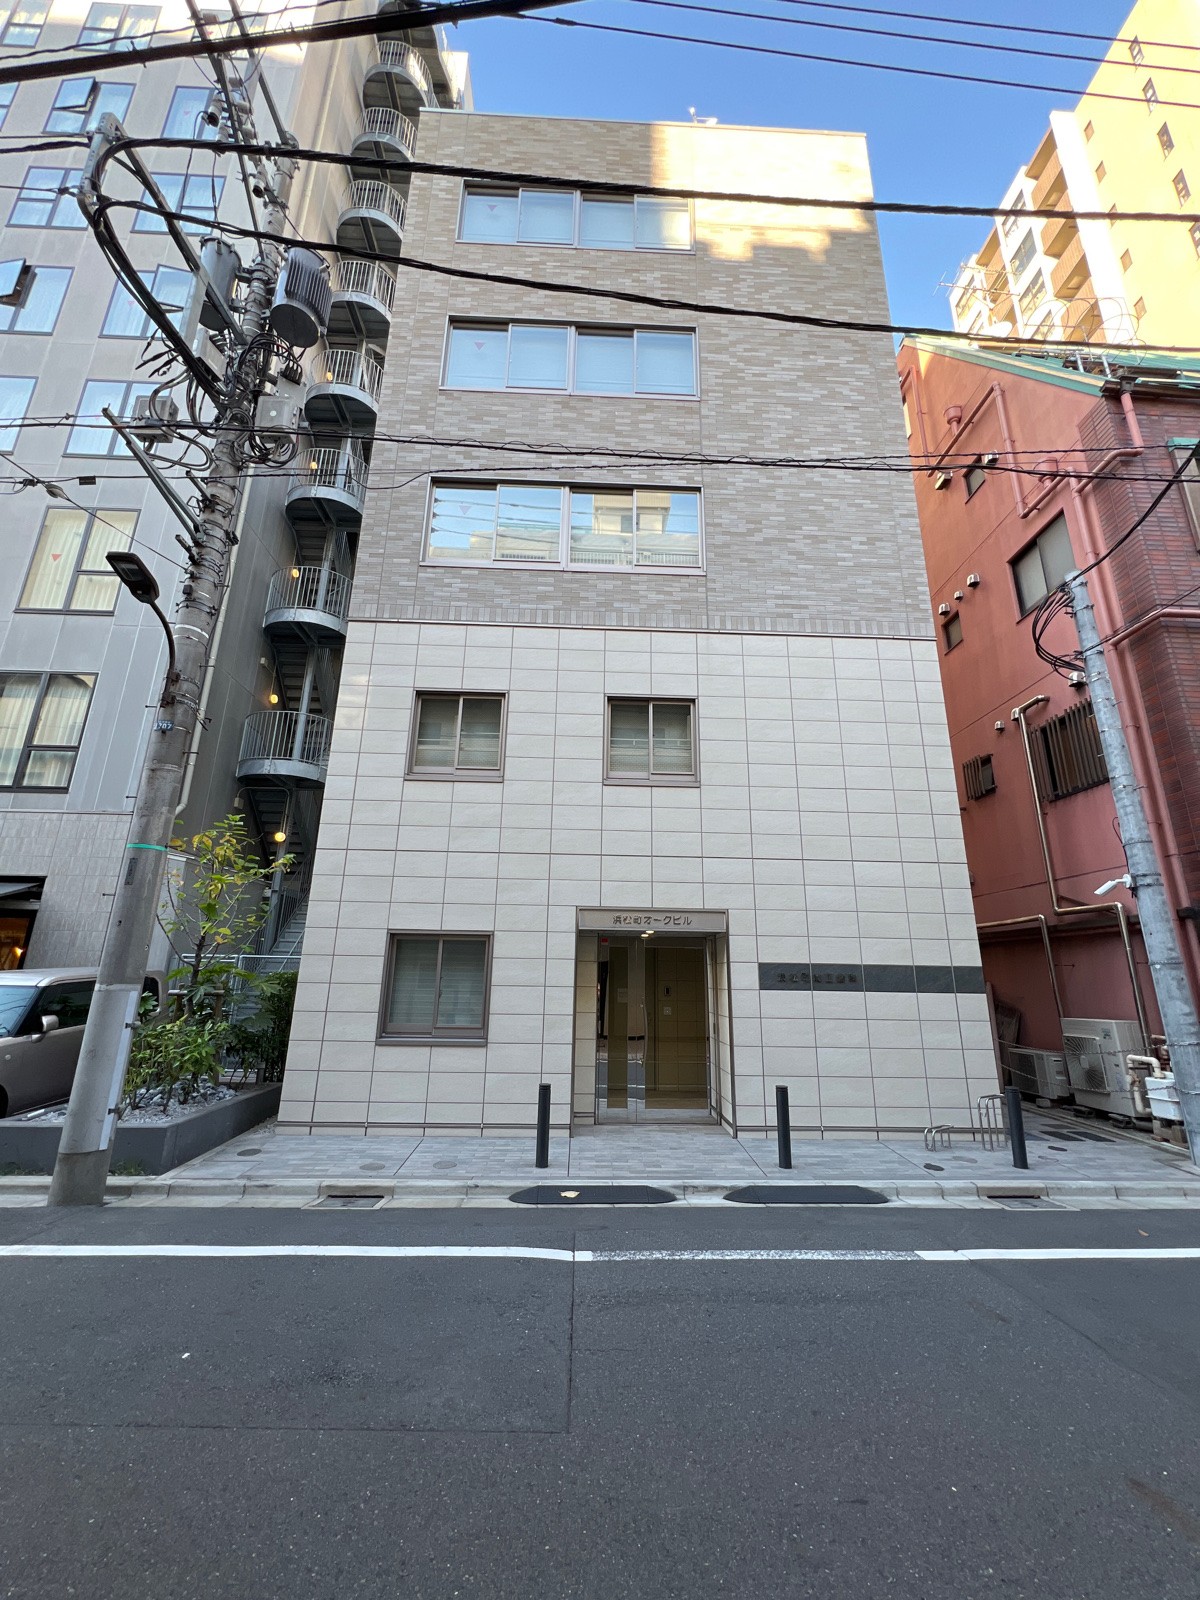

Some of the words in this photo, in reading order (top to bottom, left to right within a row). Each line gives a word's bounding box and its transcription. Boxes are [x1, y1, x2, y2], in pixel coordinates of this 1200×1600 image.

[612, 914, 693, 926] 浜松町オークビル
